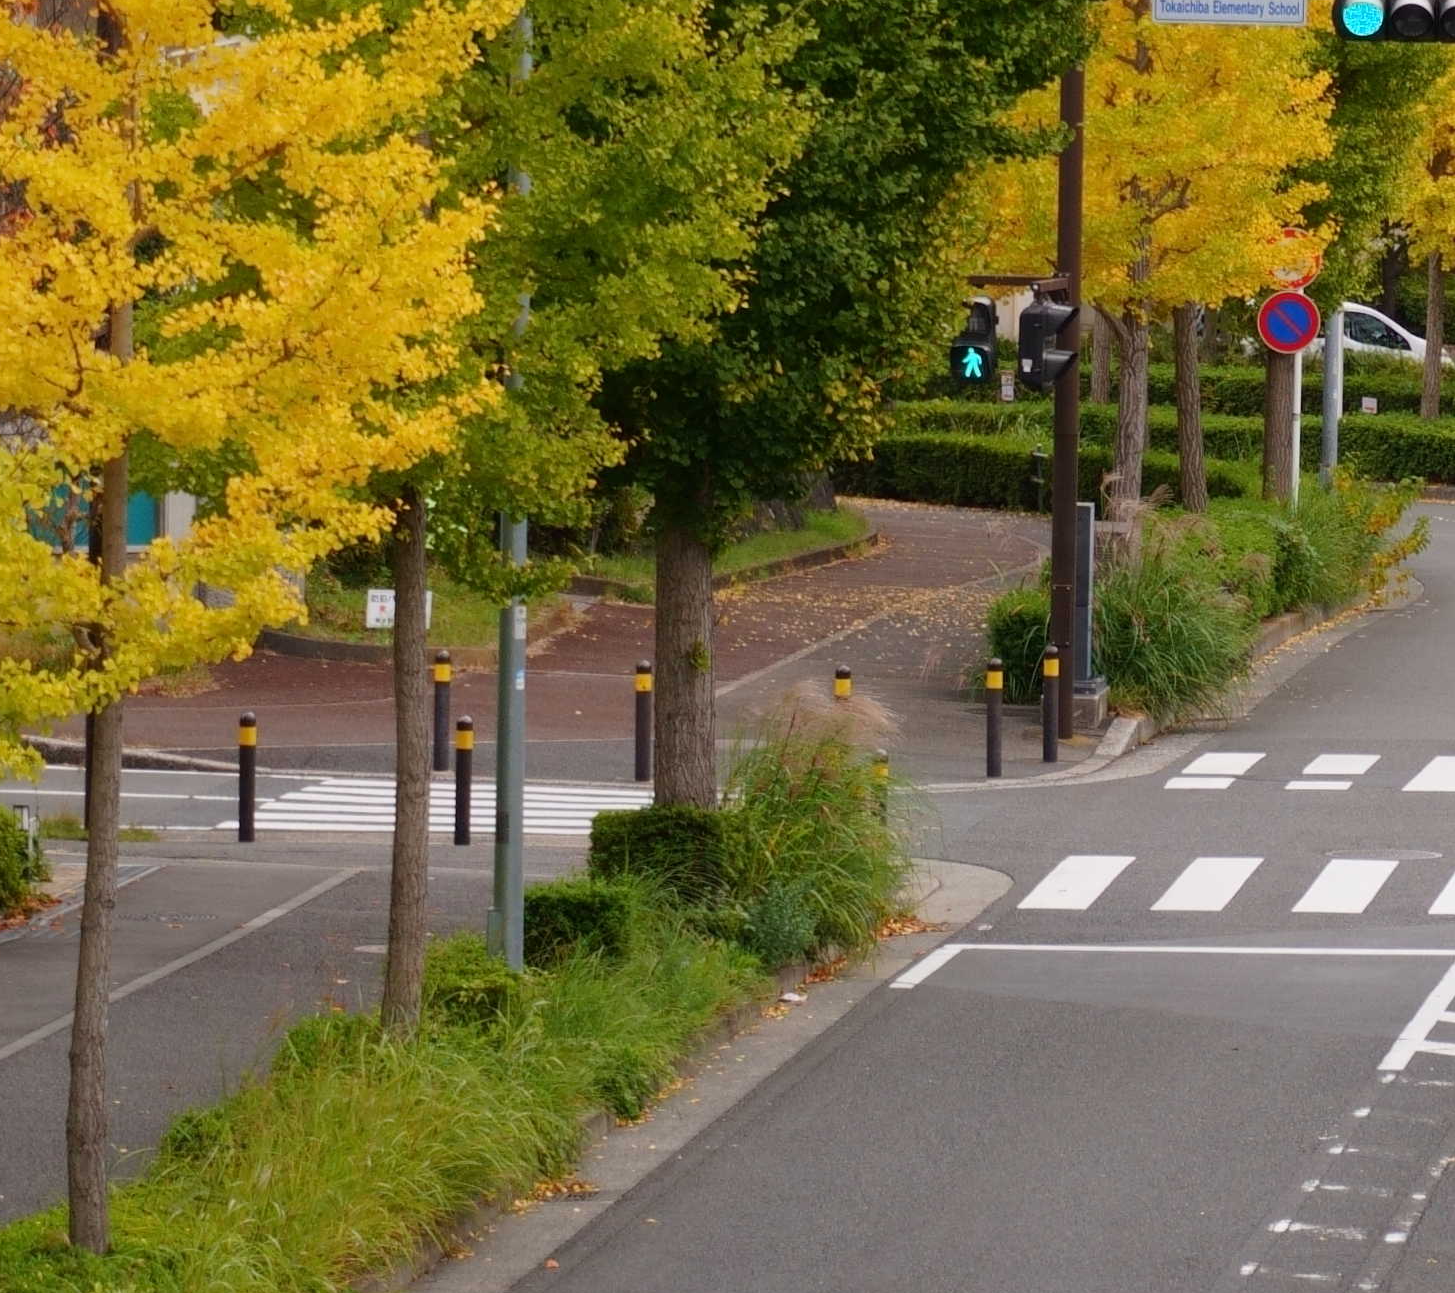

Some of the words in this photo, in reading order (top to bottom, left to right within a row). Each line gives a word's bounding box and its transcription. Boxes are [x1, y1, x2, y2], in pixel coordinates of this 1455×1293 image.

[1160, 0, 1209, 14] Tokaichiba
[1213, 0, 1264, 18] Elementary
[1268, 1, 1300, 16] School
